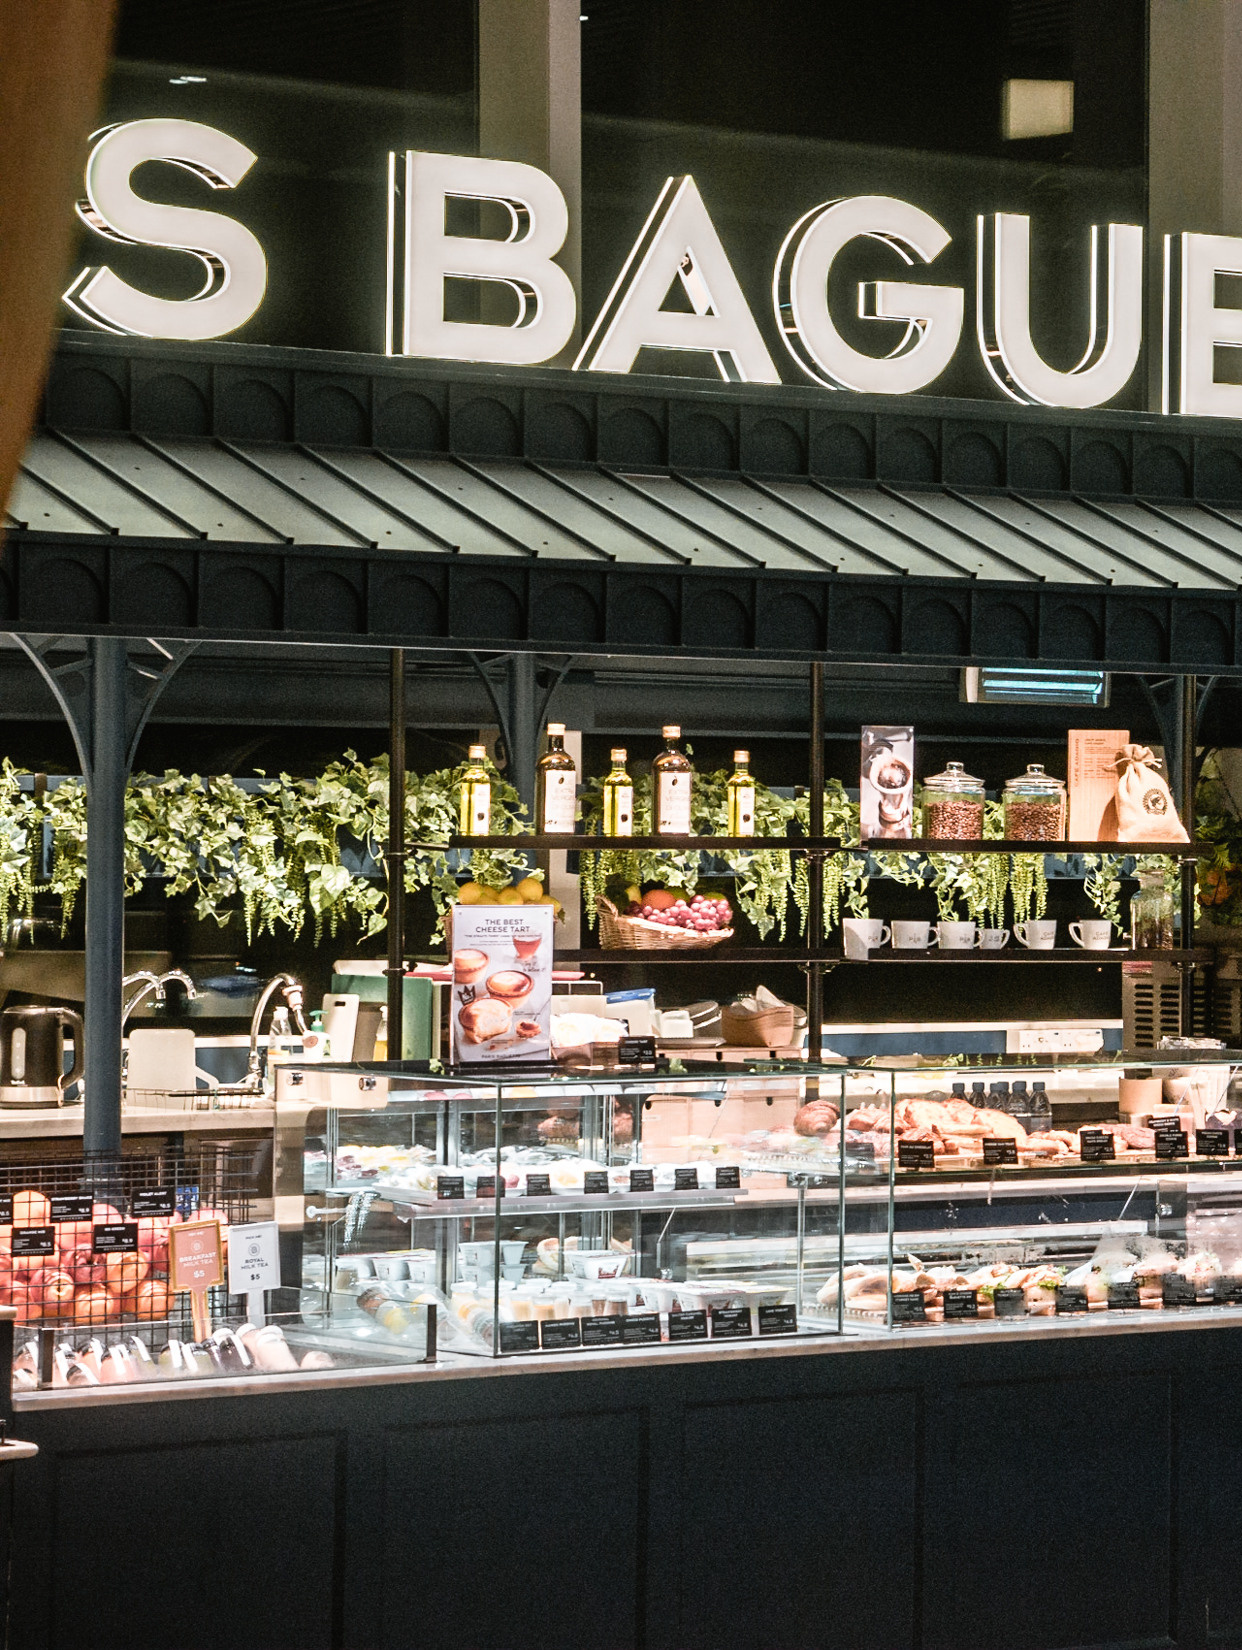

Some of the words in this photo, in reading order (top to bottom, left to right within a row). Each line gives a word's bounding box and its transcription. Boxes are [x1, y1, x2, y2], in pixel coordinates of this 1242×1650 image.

[179, 1251, 217, 1263] BREAKFAST
[193, 1269, 205, 1278] $5
[250, 1273, 261, 1281] $5
